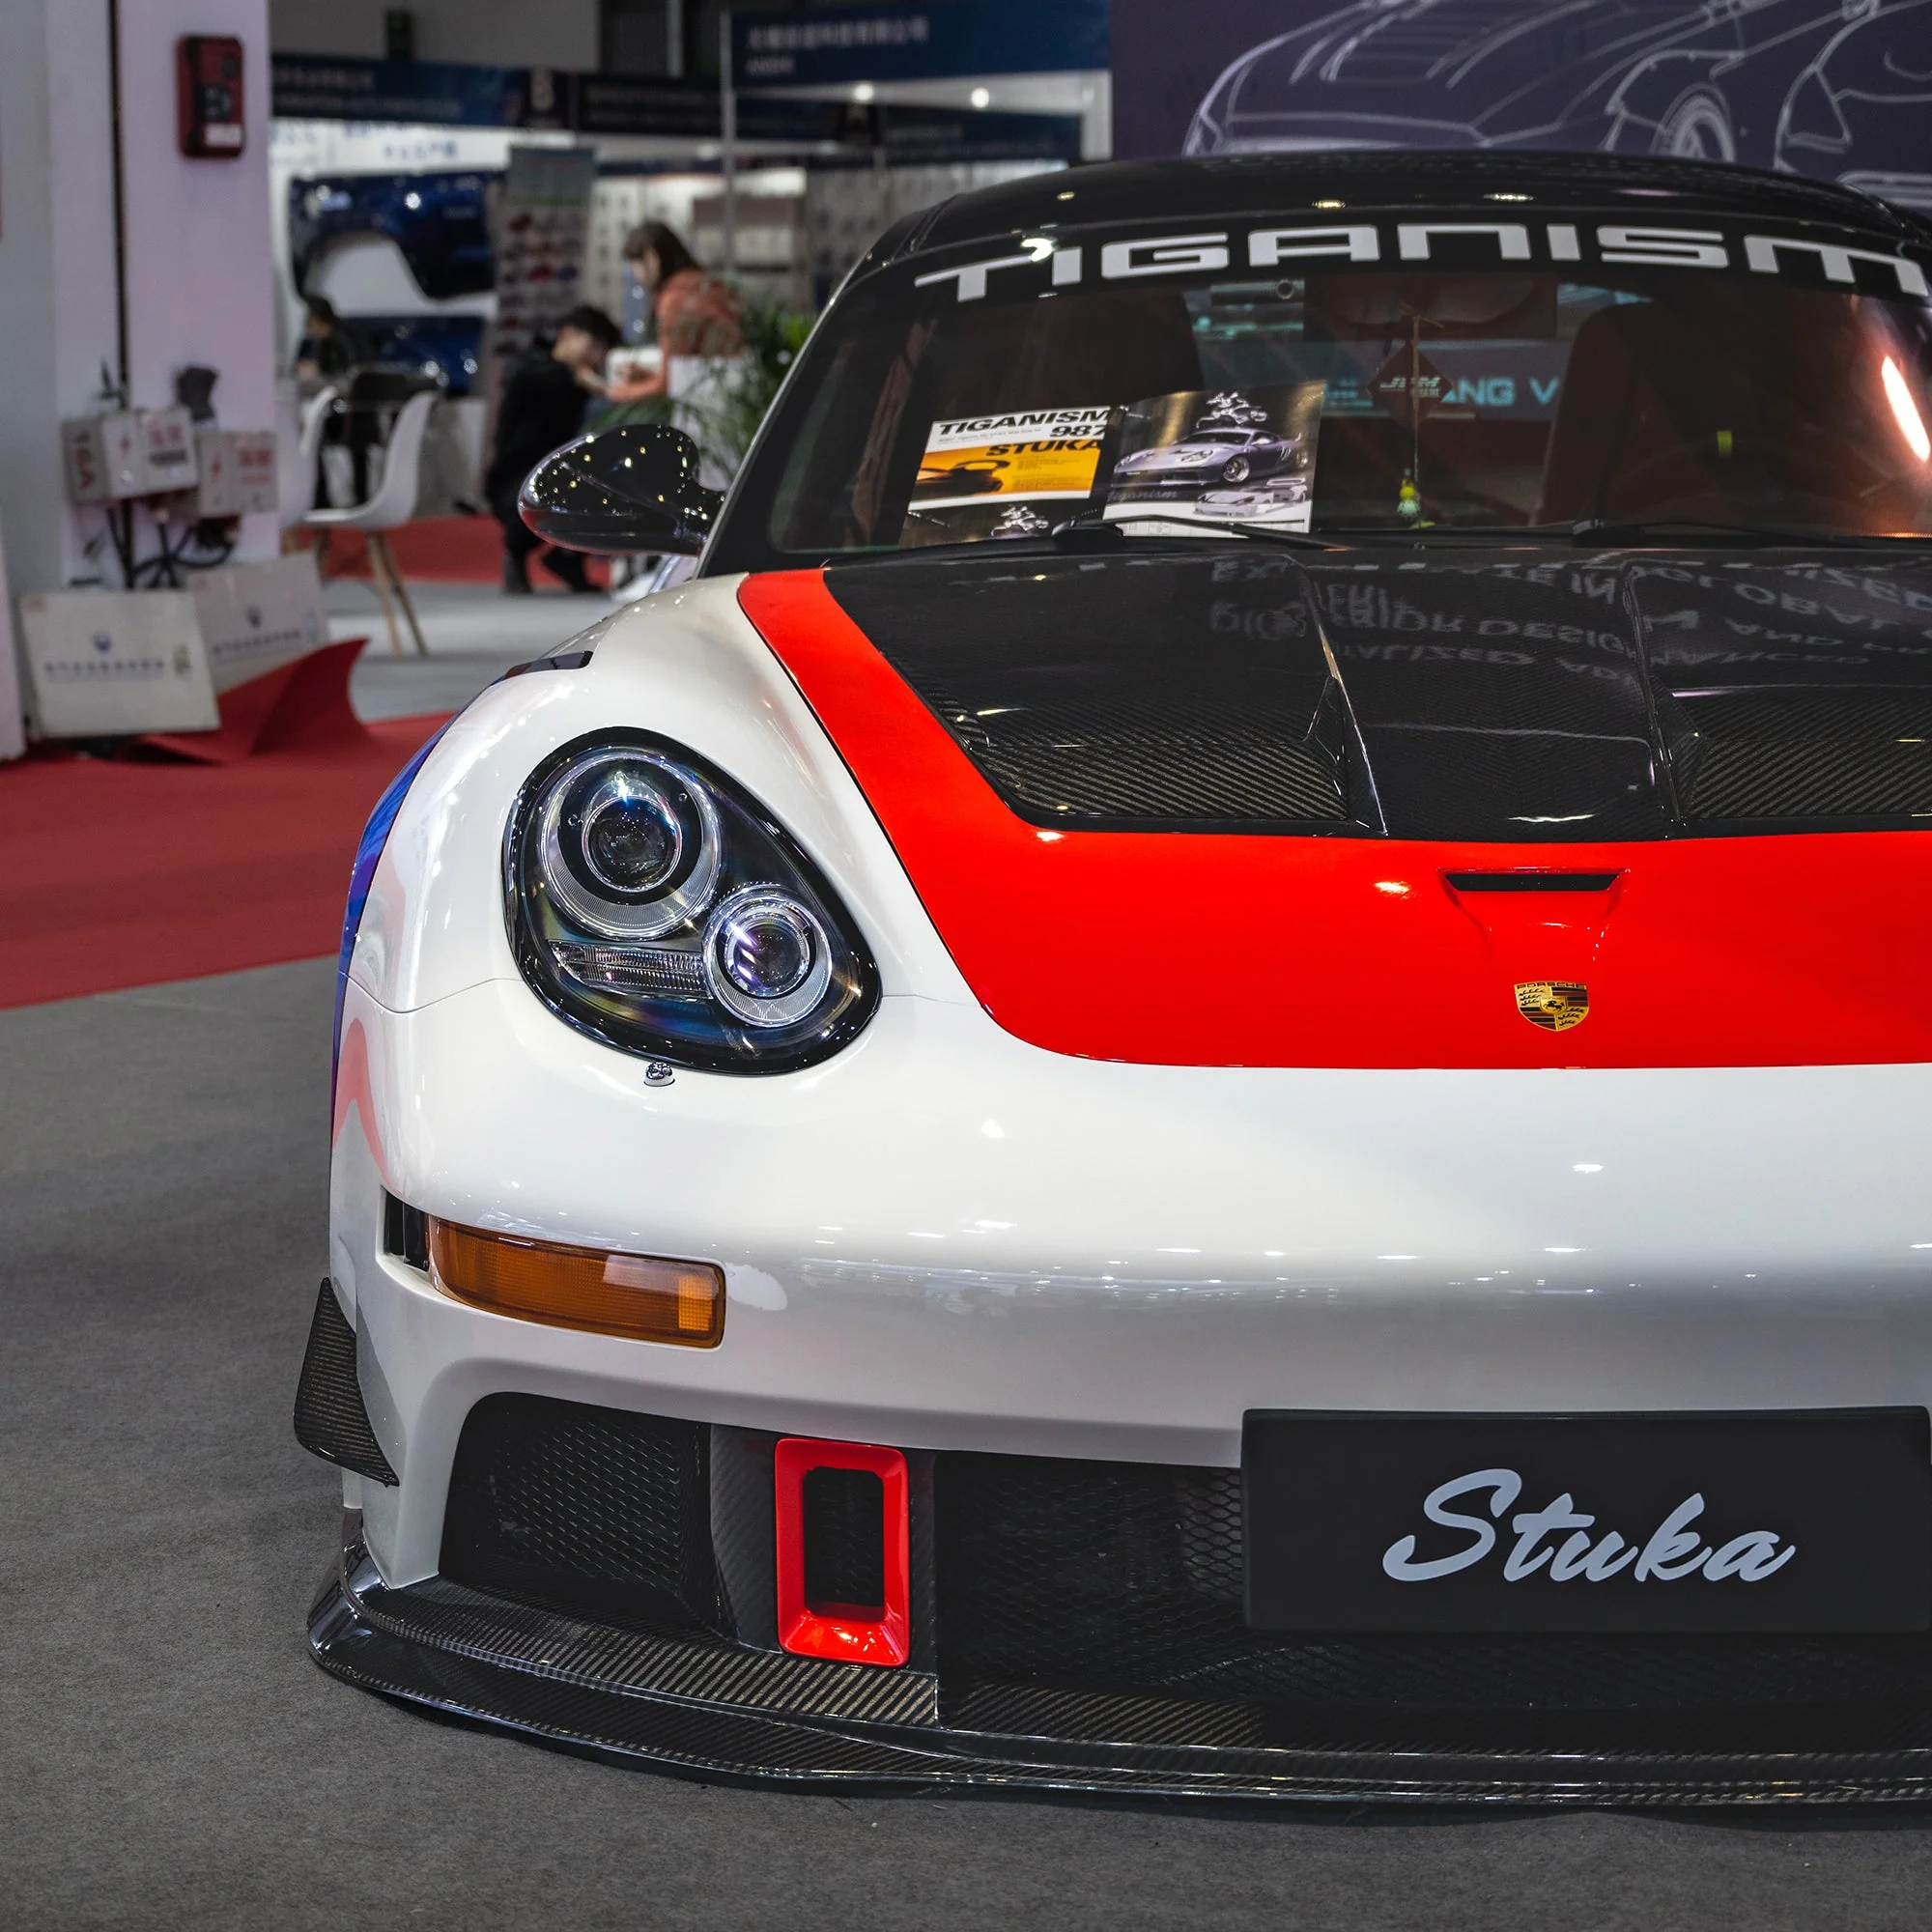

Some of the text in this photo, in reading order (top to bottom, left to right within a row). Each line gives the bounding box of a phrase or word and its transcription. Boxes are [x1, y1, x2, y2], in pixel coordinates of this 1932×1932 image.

[913, 222, 1930, 302] TIGANISM
[939, 408, 1110, 436] TIGANISM
[986, 439, 1100, 457] STUKA
[1517, 981, 1585, 990] PORSCHE
[1381, 1467, 1795, 1582] Stuka
